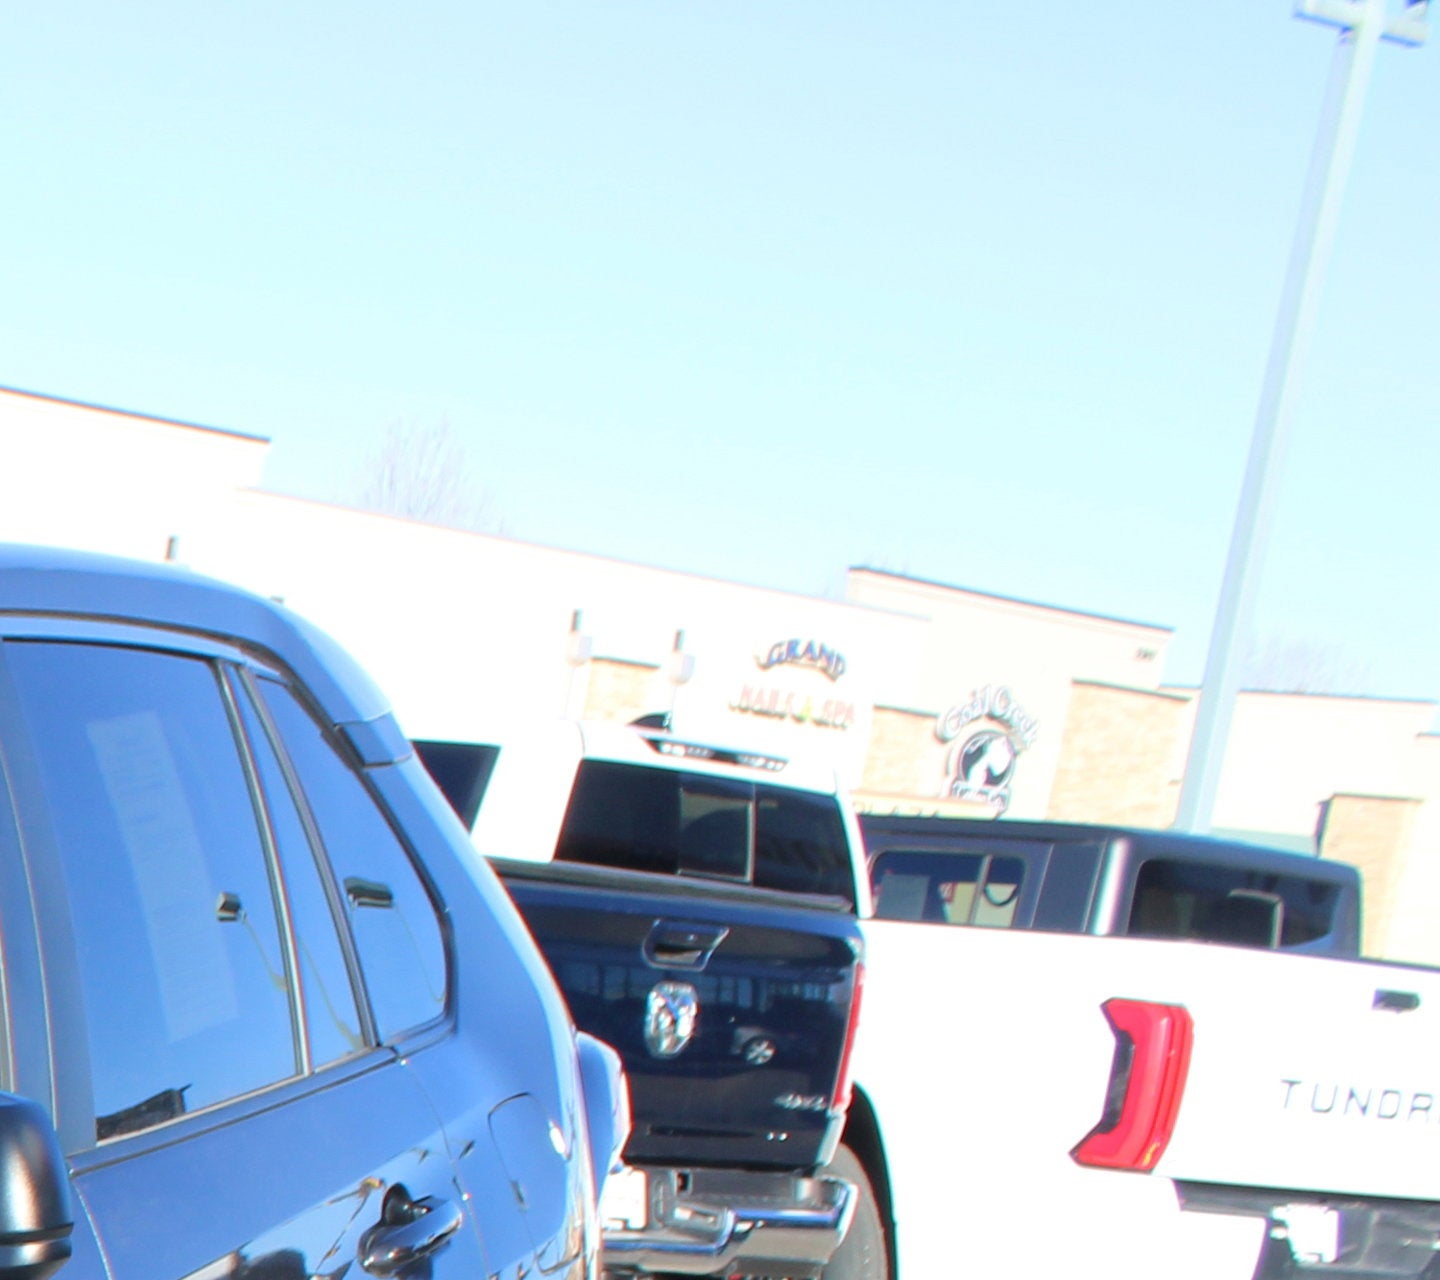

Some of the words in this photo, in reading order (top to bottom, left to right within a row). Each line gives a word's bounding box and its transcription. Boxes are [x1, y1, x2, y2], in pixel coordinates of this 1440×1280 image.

[765, 638, 848, 681] GRAND
[737, 686, 794, 717] NAILS
[822, 699, 856, 728] SPA
[1280, 1078, 1440, 1124] TUNDR
